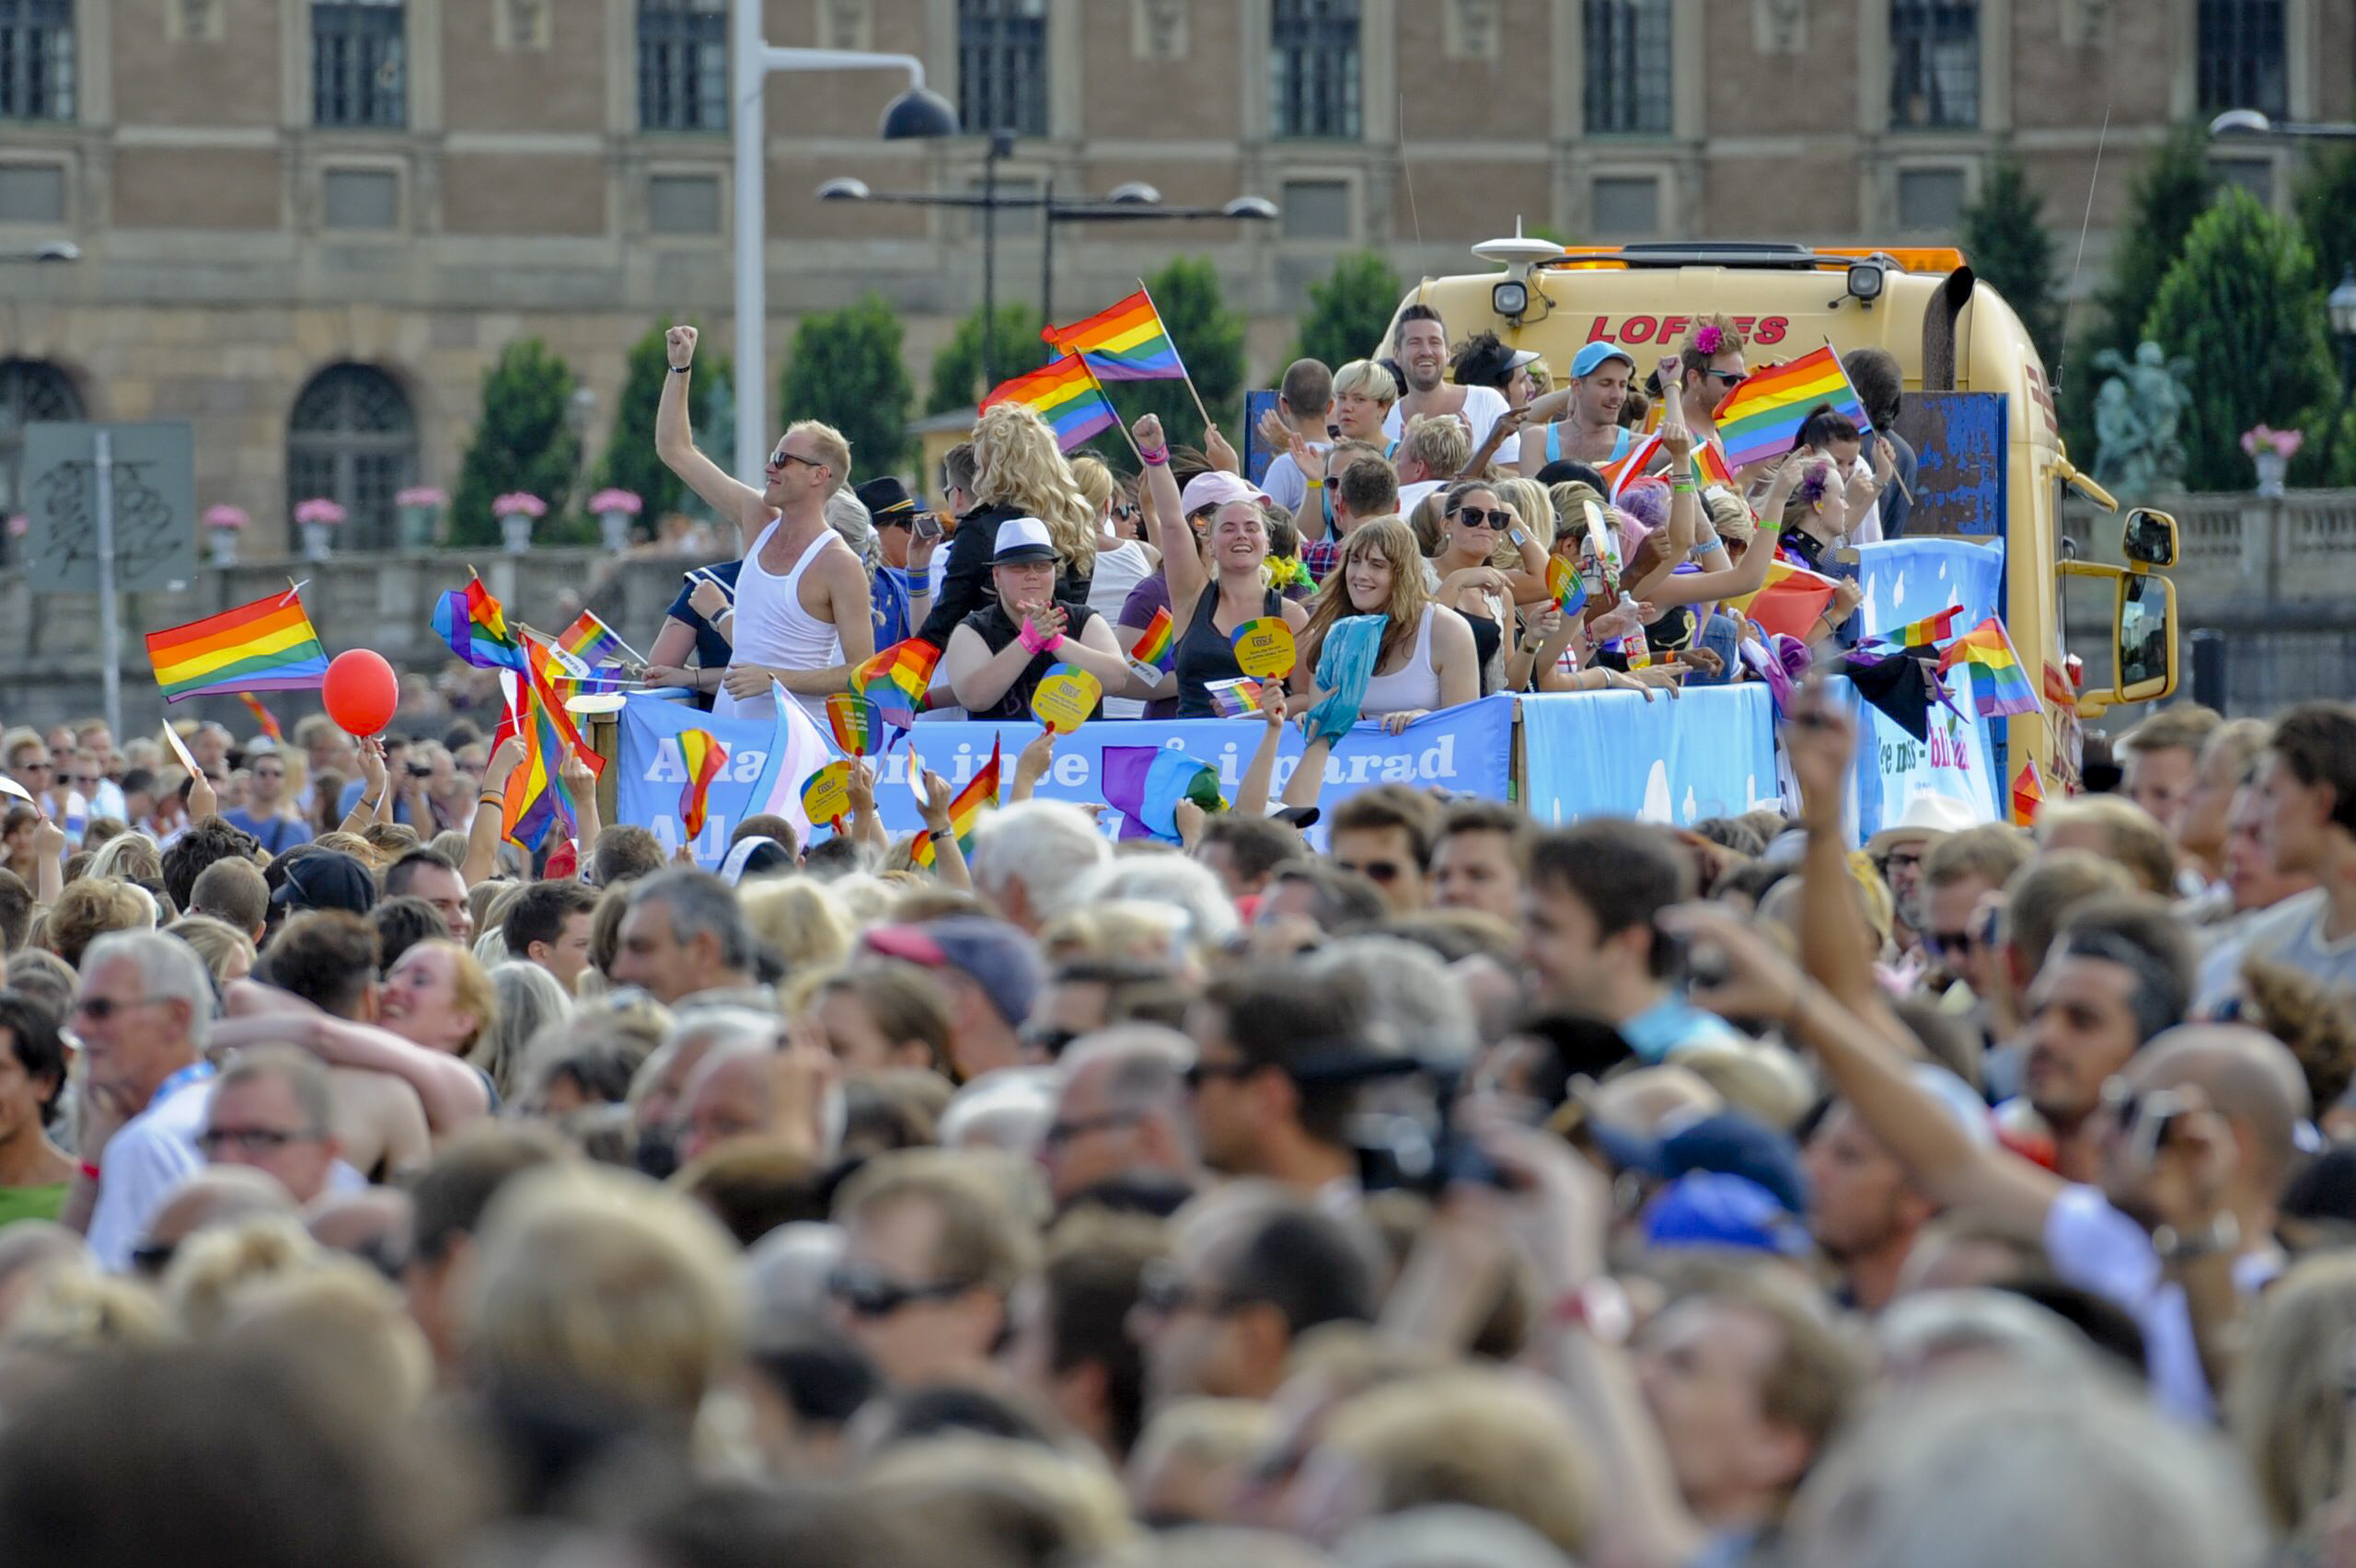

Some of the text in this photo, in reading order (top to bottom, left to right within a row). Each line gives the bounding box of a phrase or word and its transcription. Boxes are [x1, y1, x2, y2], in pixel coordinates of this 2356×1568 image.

[1586, 315, 1788, 345] LOFES
[643, 737, 768, 783] Ala
[952, 743, 1090, 787] ine
